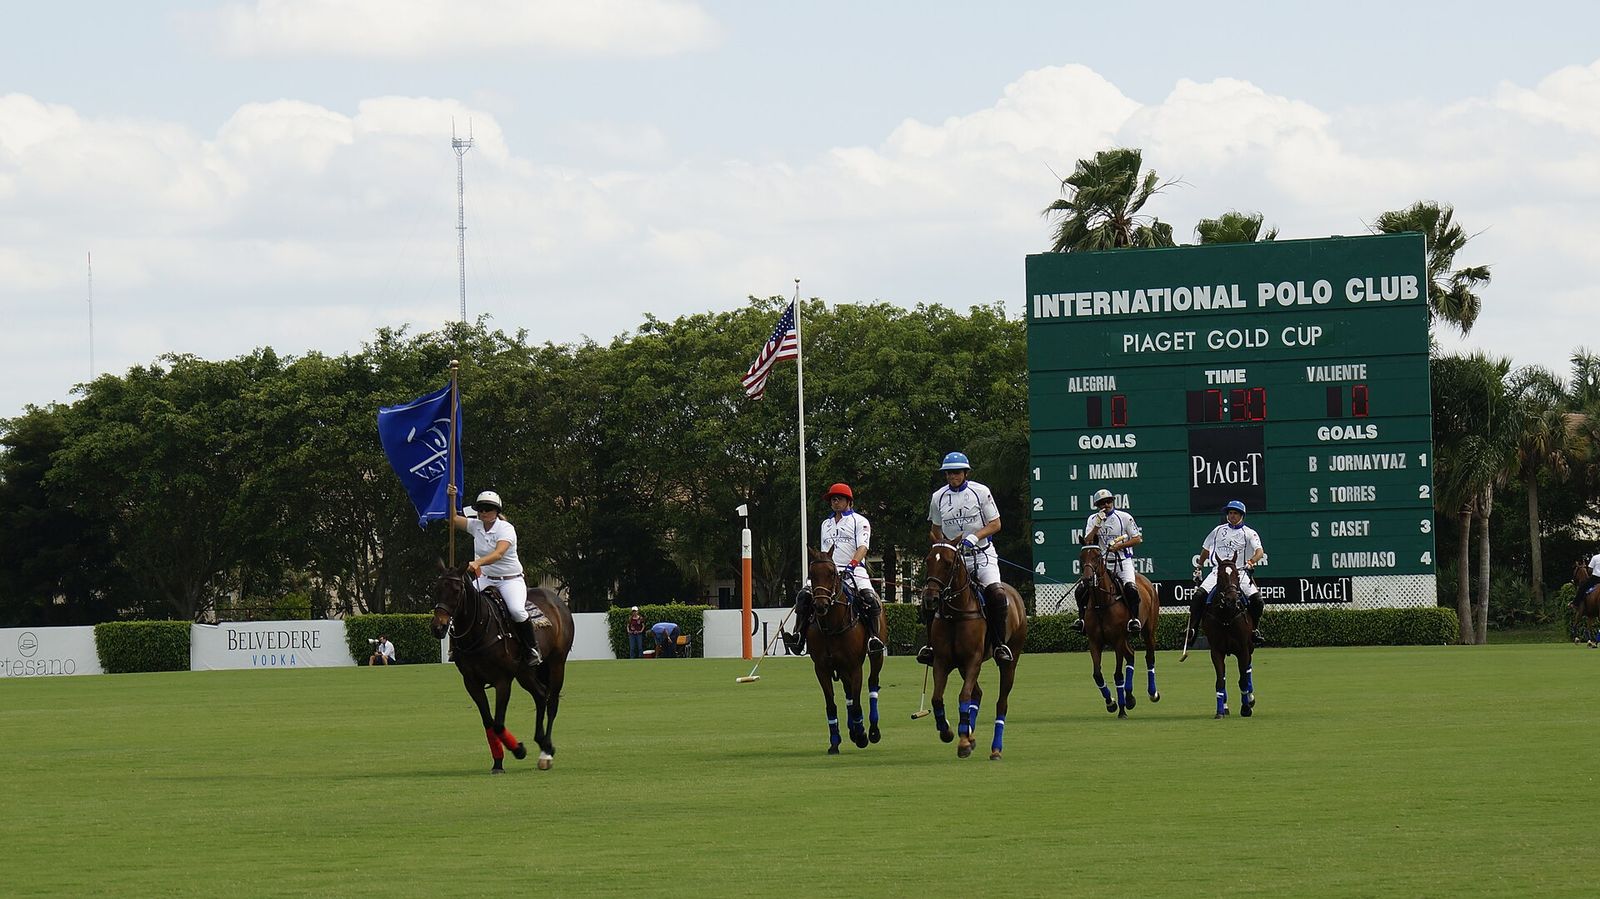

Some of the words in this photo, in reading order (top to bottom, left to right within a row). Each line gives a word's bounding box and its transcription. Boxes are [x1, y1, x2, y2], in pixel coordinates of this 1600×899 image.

[1033, 284, 1247, 318] INTERNATIONAL
[1257, 279, 1333, 307] POLO
[1345, 275, 1419, 303] CLUB
[1123, 331, 1196, 352] PIAGET
[1207, 328, 1270, 350] GOLD
[1281, 325, 1323, 347] CUP
[1204, 369, 1247, 384] TIME
[1306, 364, 1367, 382] VALIENTE
[1068, 375, 1117, 393] ALEGRIA
[1078, 433, 1137, 449] GOALS
[1317, 424, 1378, 441] GOALS
[1032, 467, 1041, 480] 1
[1069, 464, 1077, 480] J
[1089, 462, 1138, 480] MANNIX
[1191, 452, 1263, 488] PIAGET
[1308, 456, 1318, 472] B
[1329, 453, 1407, 472] JORNAYVAZ
[1418, 453, 1427, 467] 1
[1309, 487, 1319, 503] S
[1329, 485, 1376, 503] TORRES
[1419, 484, 1430, 499] 2
[1033, 497, 1044, 511] 2
[1070, 495, 1078, 511] H
[1310, 521, 1320, 537] S
[1330, 520, 1370, 537] CASET
[1420, 519, 1431, 534] 3
[1034, 530, 1045, 545] 3
[1035, 561, 1046, 575] 4
[1311, 553, 1320, 569] A
[1331, 551, 1396, 569] CAMBIASO
[1420, 551, 1432, 565] 4
[1299, 577, 1350, 602] PIAGET
[227, 629, 321, 652] BELVEDERE
[252, 653, 296, 666] VODKA
